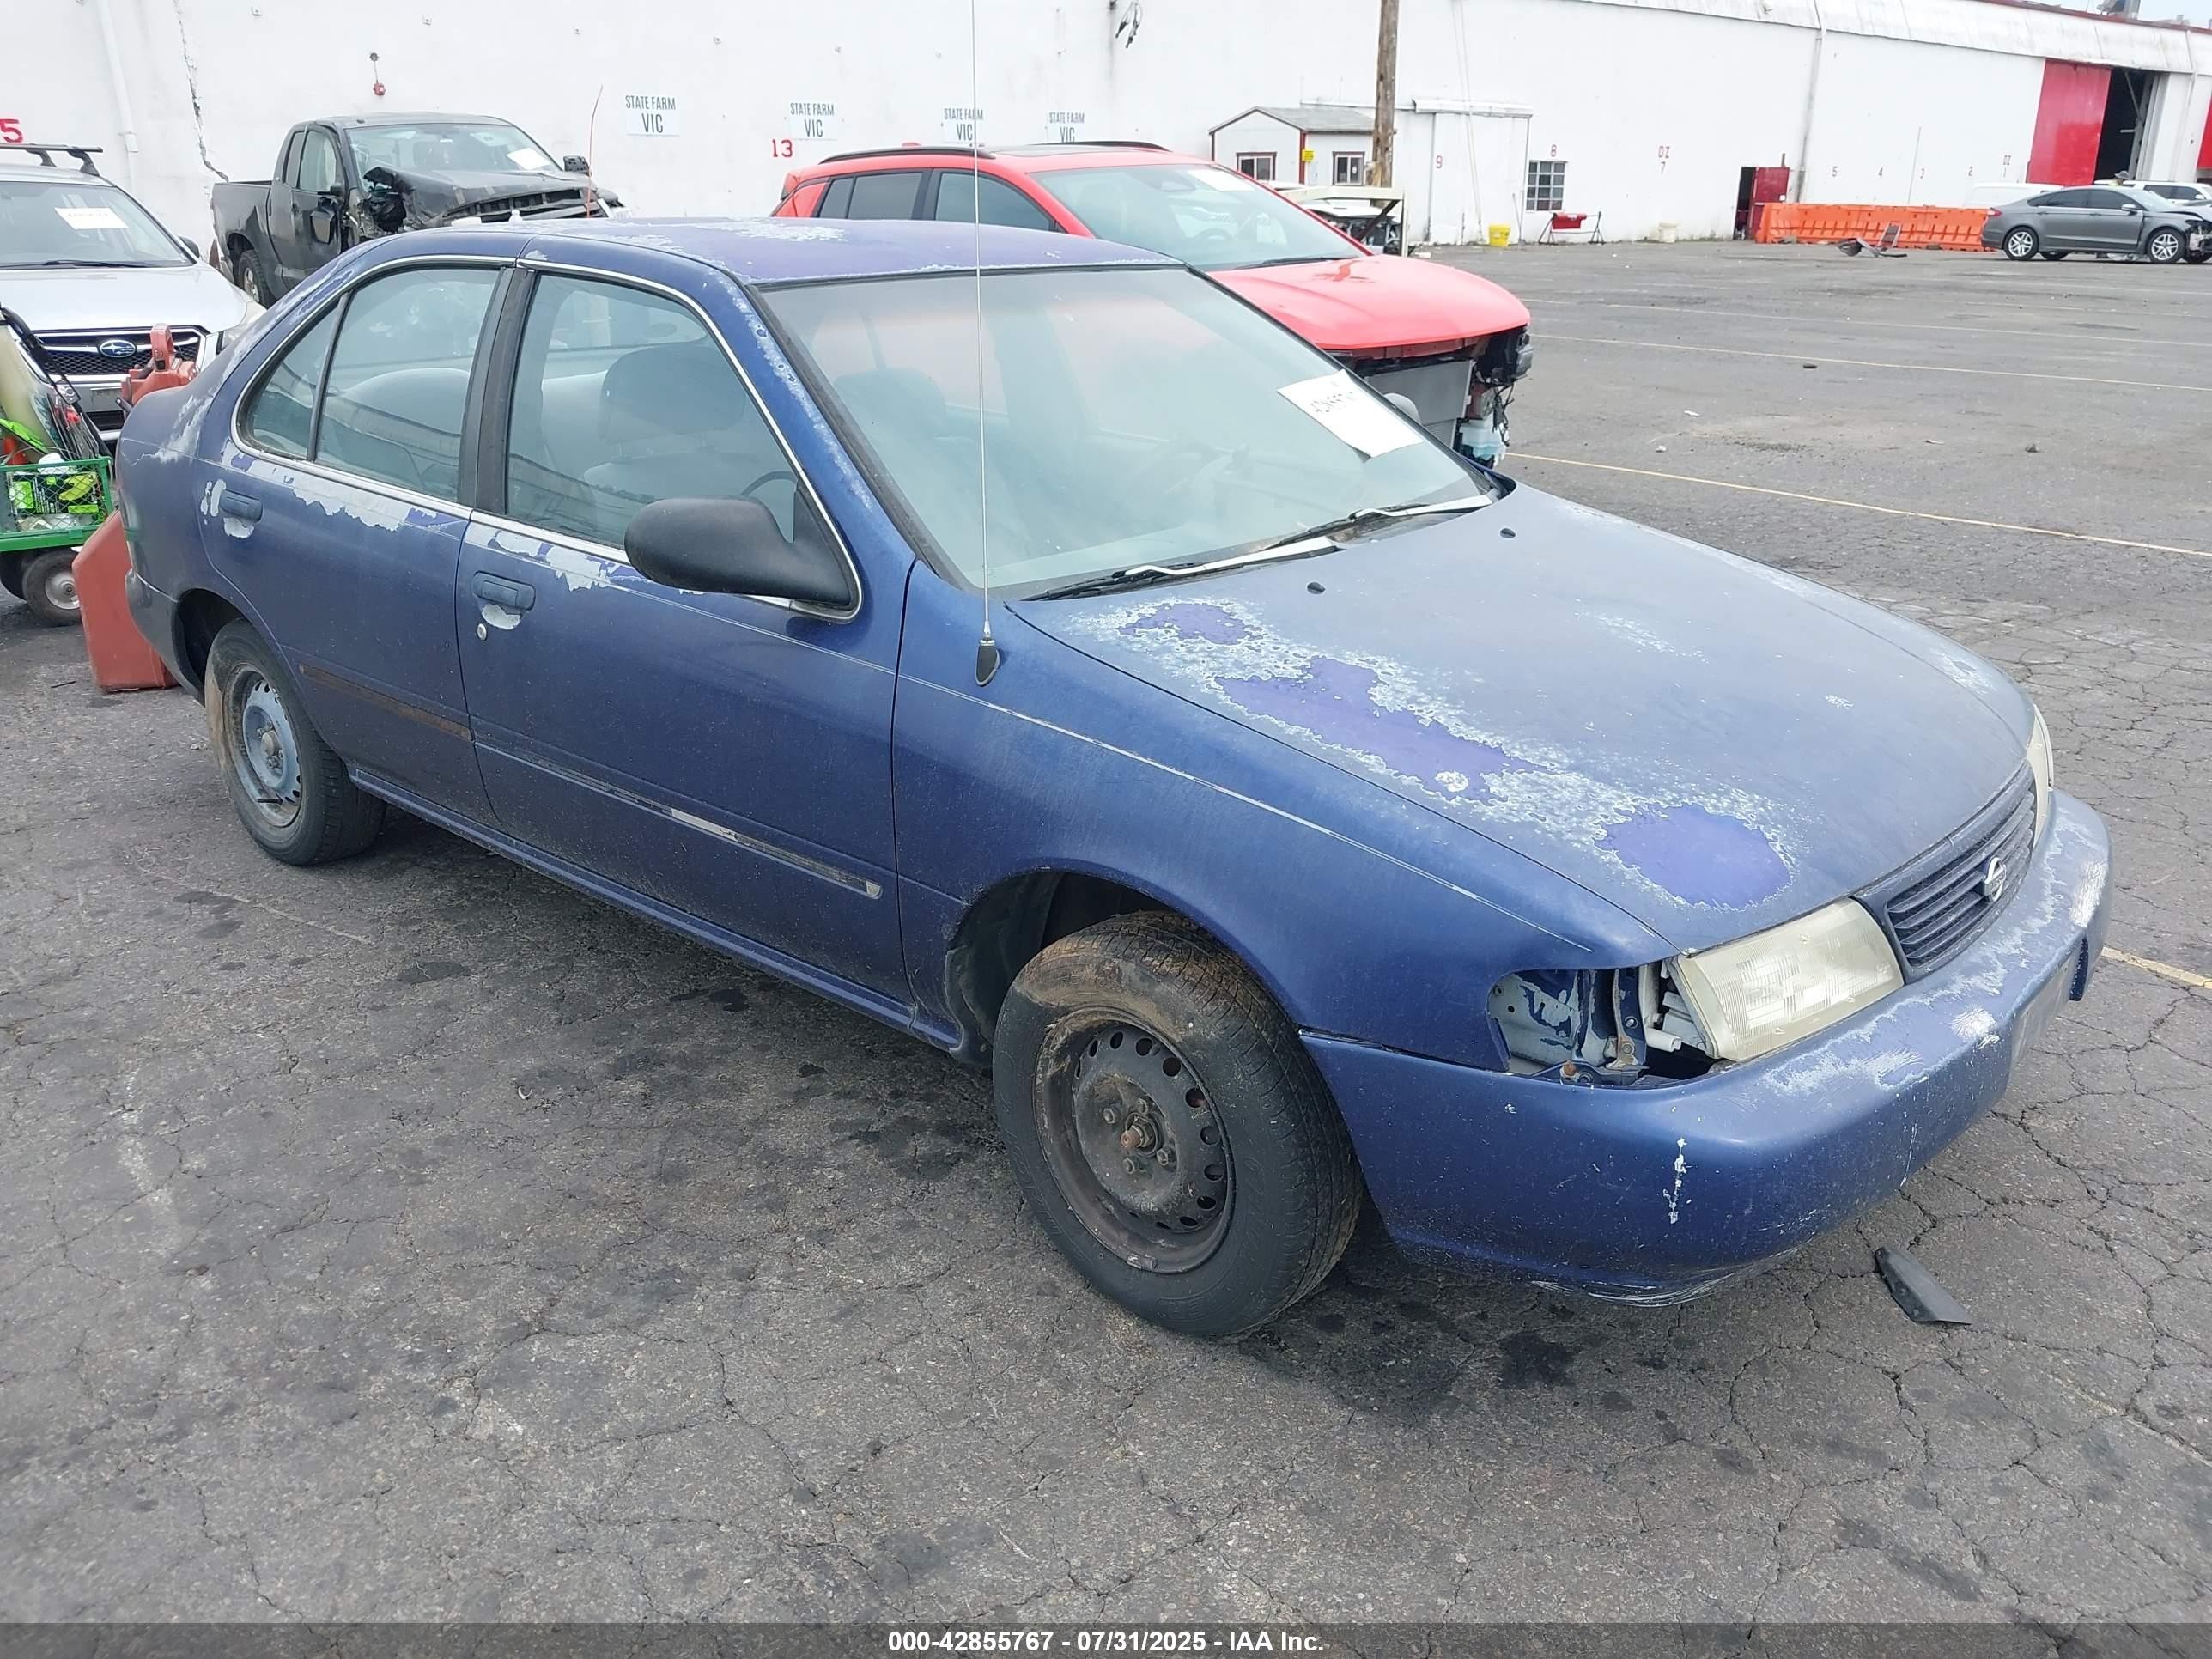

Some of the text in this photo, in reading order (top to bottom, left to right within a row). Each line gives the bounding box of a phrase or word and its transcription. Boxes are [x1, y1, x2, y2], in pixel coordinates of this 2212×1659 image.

[625, 94, 677, 111] STATE FARM
[790, 102, 835, 117] STATE FARM
[944, 108, 963, 120] STATE
[1048, 112, 1085, 124] STATE FARM
[641, 112, 664, 134] VIC
[804, 118, 823, 138] VIC
[956, 123, 973, 141] VIC
[1060, 126, 1075, 143] VIC
[771, 138, 793, 158] 13
